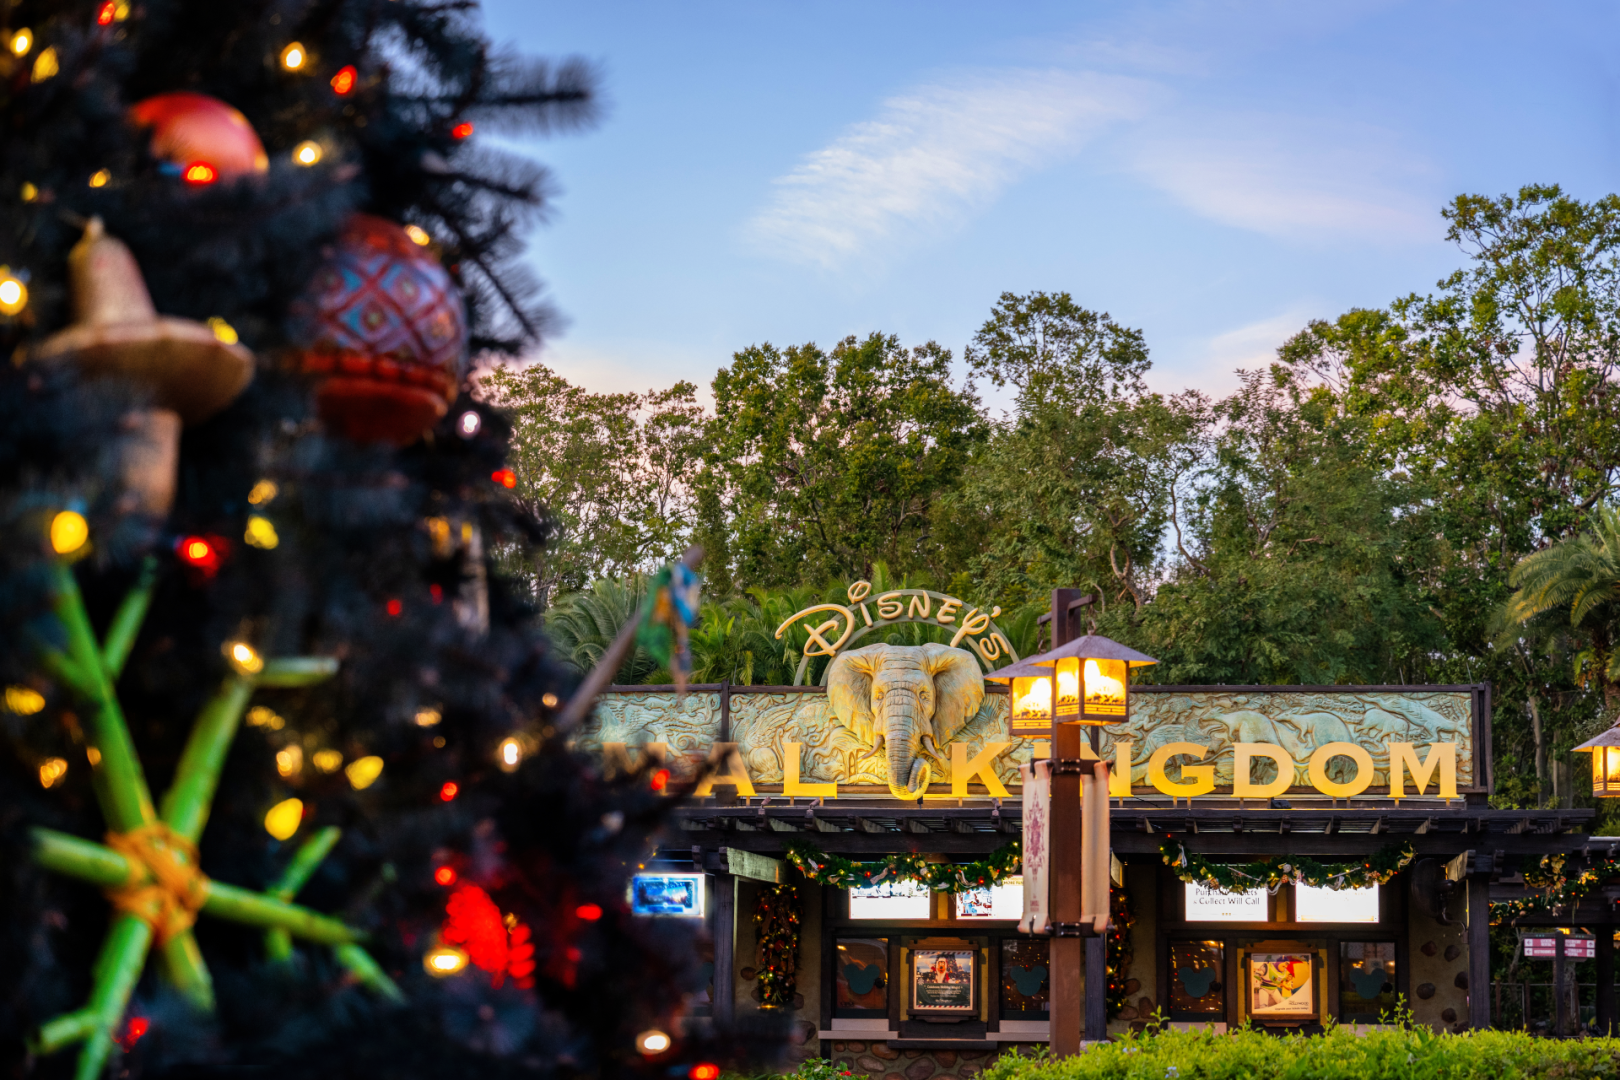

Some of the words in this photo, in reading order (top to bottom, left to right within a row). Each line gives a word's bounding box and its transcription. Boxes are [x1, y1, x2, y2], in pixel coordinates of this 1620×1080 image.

[1199, 897, 1226, 905] Collect
[1227, 897, 1243, 905] Will
[1245, 897, 1260, 905] Call
